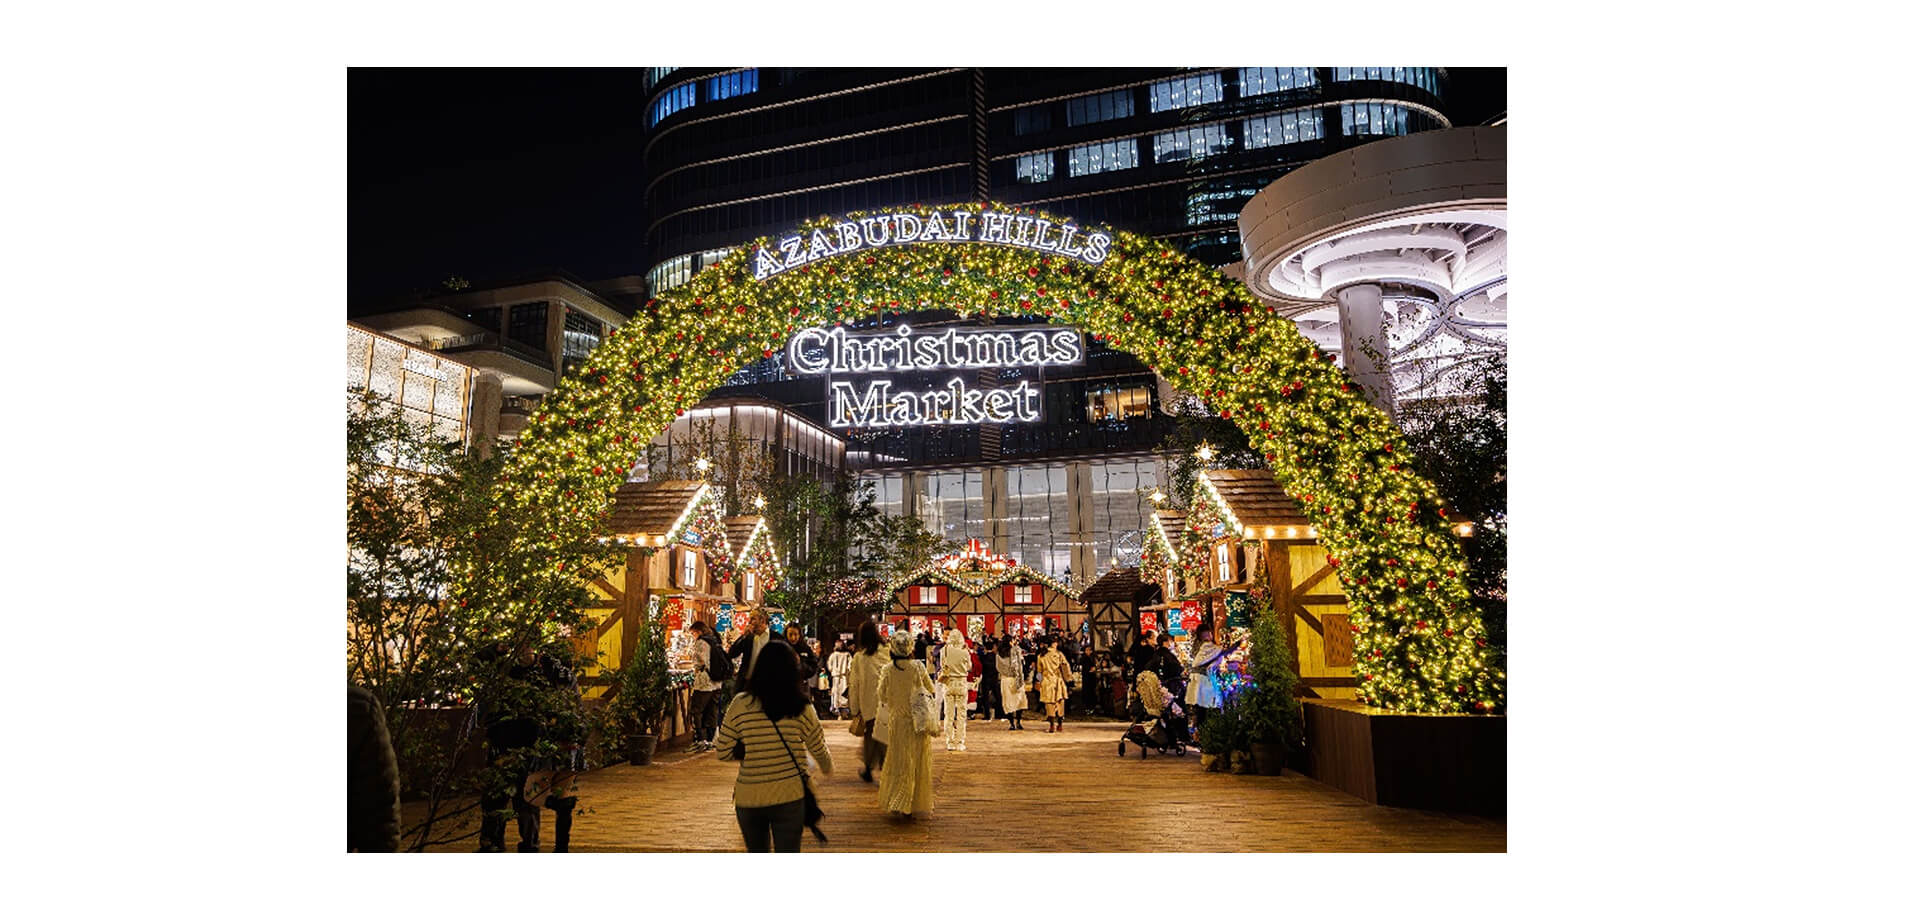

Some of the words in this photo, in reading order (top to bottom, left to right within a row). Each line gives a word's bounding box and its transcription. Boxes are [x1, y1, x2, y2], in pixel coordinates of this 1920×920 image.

[755, 211, 967, 279] AZABUDAI
[980, 212, 1111, 263] HILLS
[790, 325, 1080, 374] Christmas
[831, 378, 1039, 427] Market
